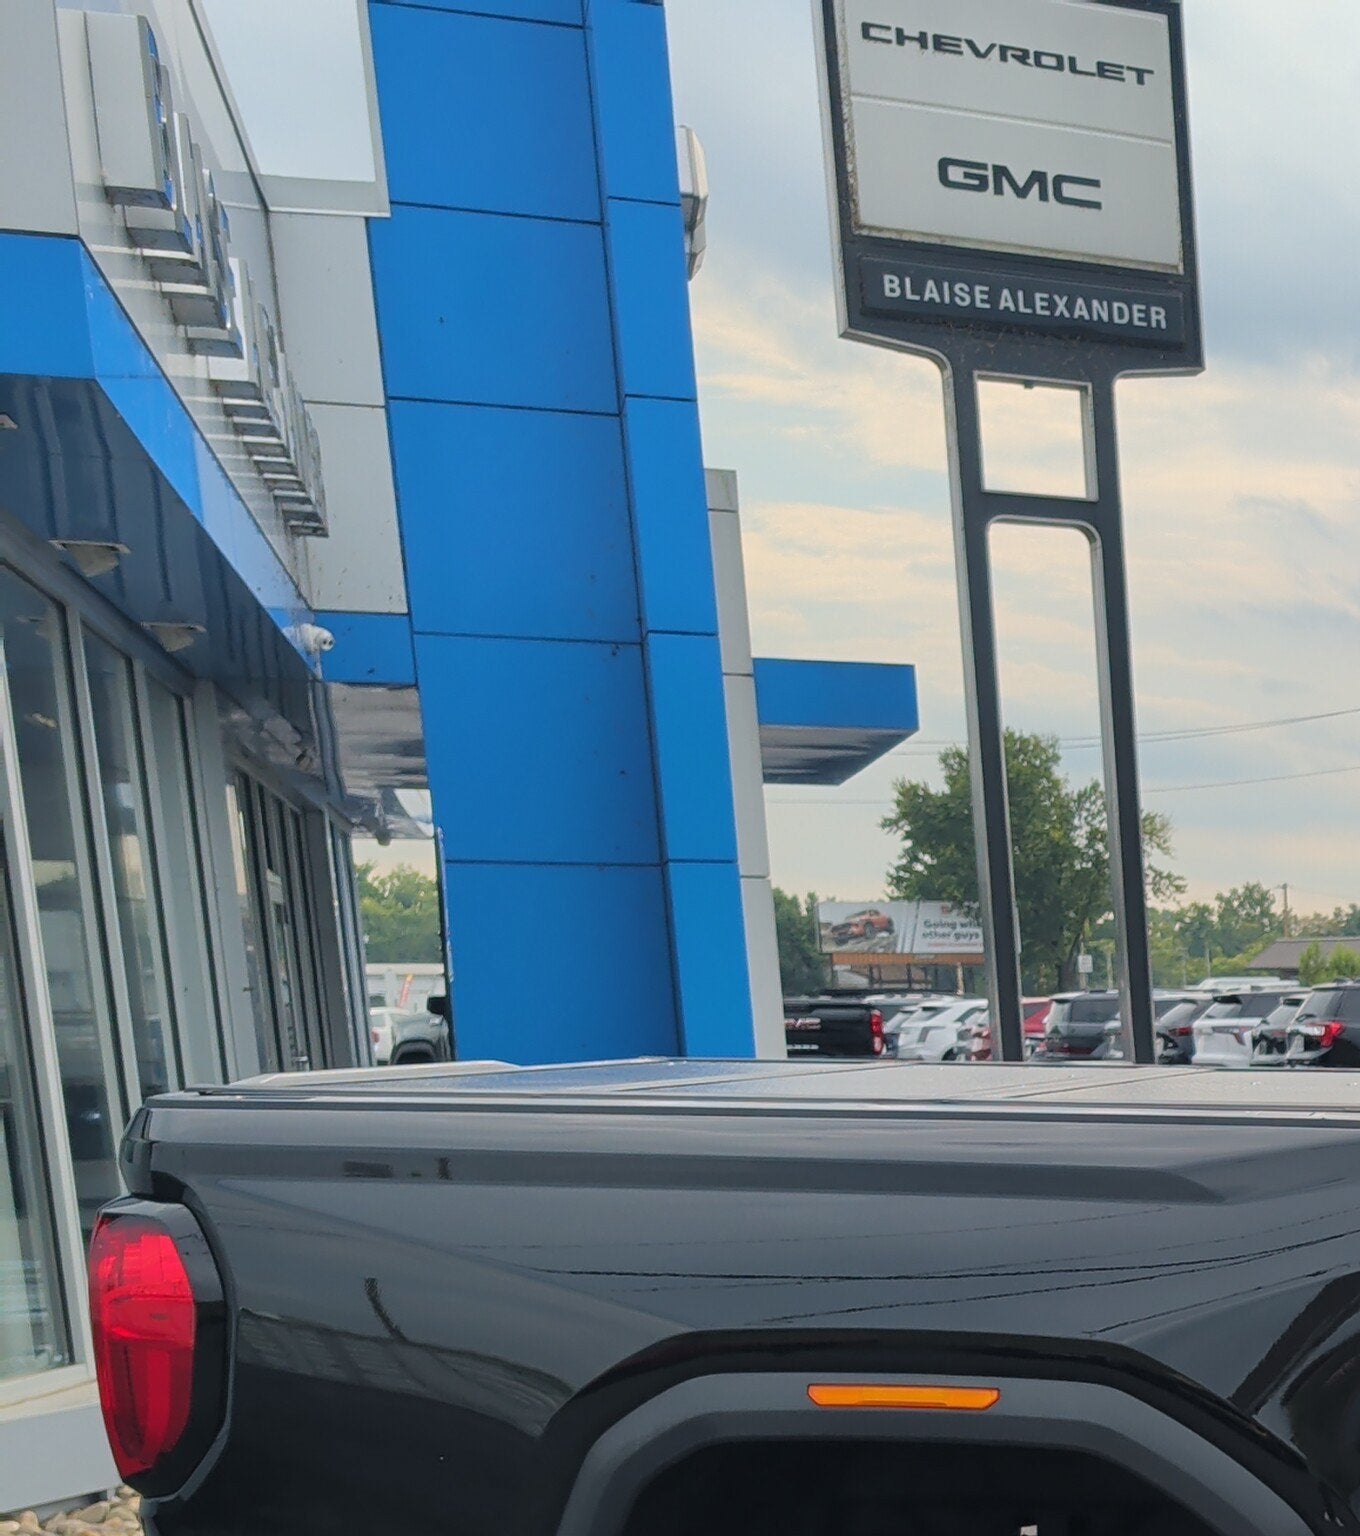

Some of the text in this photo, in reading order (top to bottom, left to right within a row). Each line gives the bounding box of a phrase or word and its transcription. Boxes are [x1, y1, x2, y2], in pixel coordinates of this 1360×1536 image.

[861, 22, 1155, 86] CHEVROLET
[938, 157, 1103, 210] GMC
[883, 273, 1168, 330] BLAISE ALEXANDER
